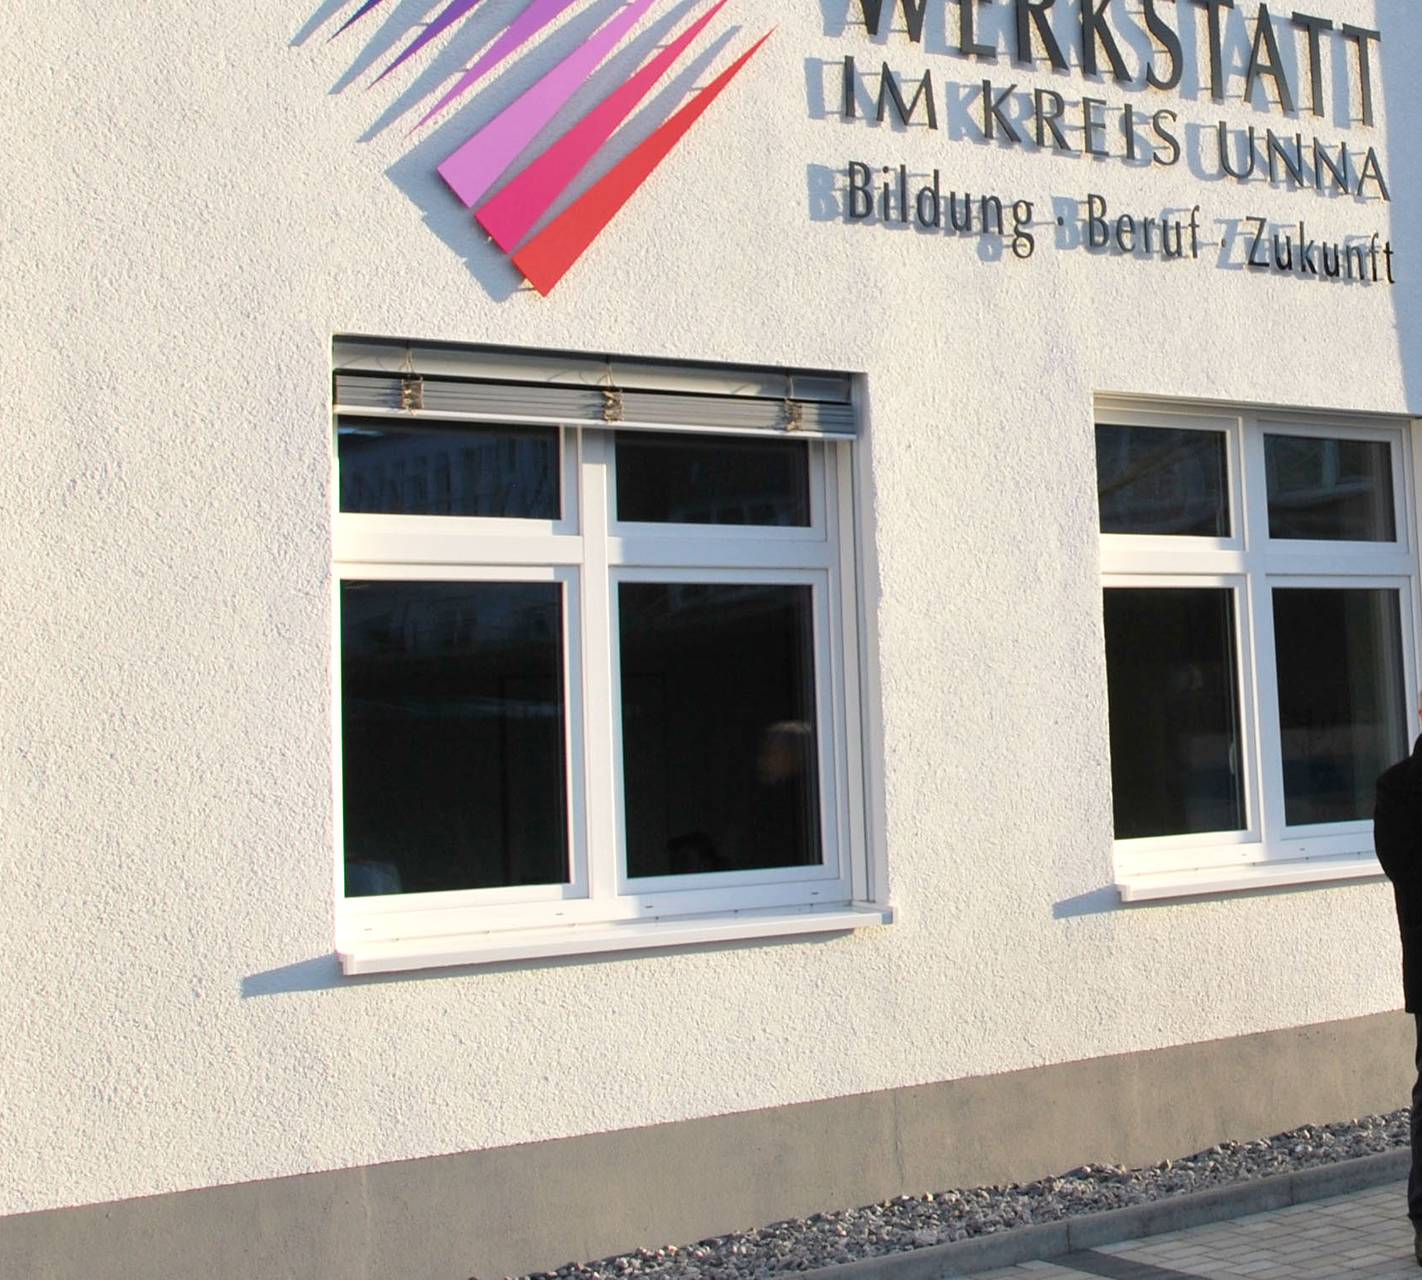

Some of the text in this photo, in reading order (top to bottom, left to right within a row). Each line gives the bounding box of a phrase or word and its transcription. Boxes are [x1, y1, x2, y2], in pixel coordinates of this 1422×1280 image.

[844, 55, 1391, 201] IM KREIS UNNA
[848, 160, 1035, 259] Bildung
[1087, 193, 1200, 259] Beruf
[1246, 215, 1395, 284] Zukunft
